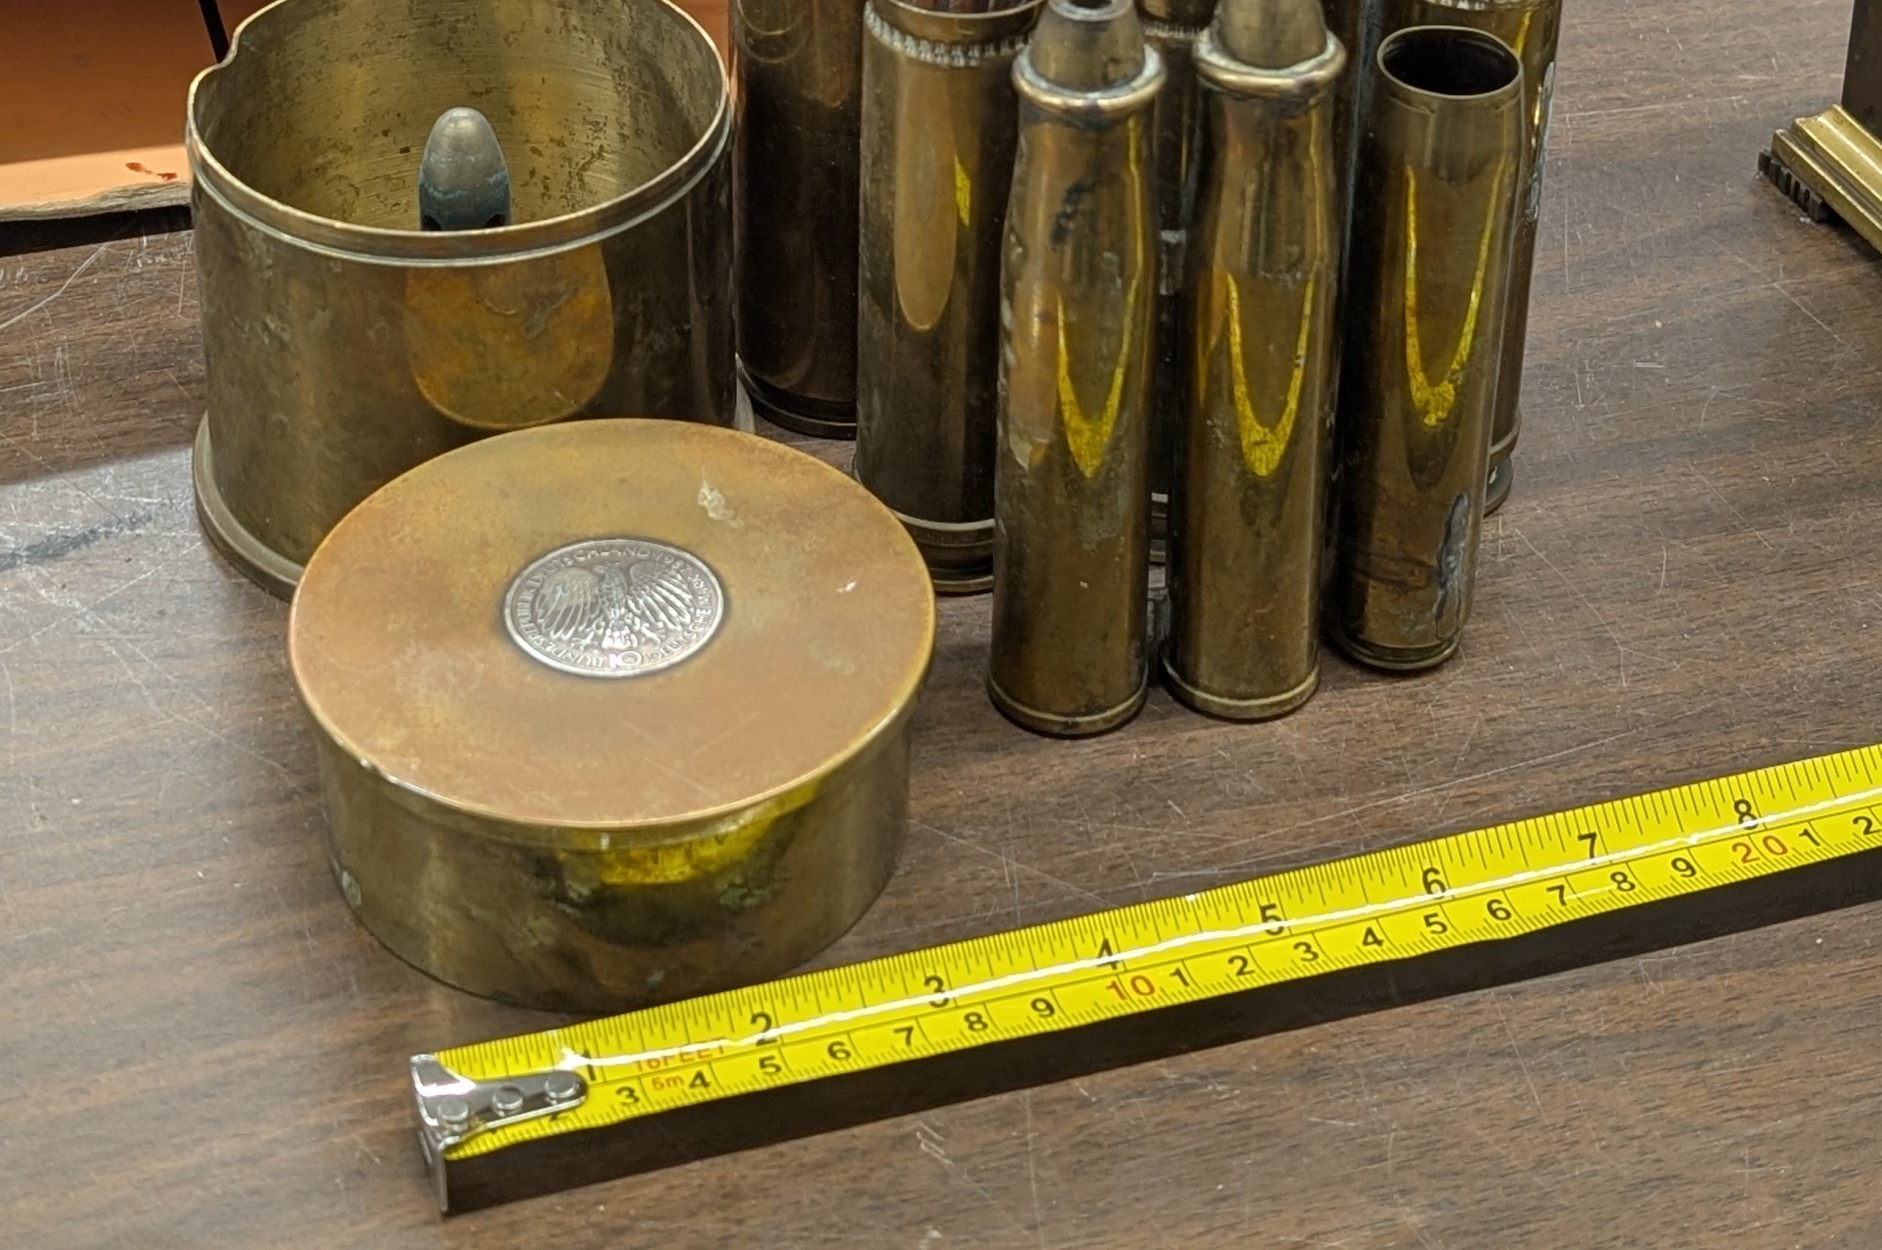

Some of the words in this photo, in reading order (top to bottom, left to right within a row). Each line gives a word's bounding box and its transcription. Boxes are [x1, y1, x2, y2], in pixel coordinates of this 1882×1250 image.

[615, 1085, 640, 1108] 3
[689, 1070, 713, 1090] 4
[758, 1055, 782, 1078] 5
[827, 1040, 852, 1062] 6
[894, 1025, 916, 1047] 7
[964, 1011, 989, 1033] 8
[1030, 997, 1056, 1019] 9
[1106, 973, 1157, 1001] 10
[1169, 967, 1193, 989] 1
[1227, 954, 1257, 978] 2
[1292, 940, 1319, 963] 3
[1361, 926, 1384, 951] 4
[1425, 912, 1449, 936] 5
[1487, 898, 1512, 922] 6
[1546, 884, 1569, 908] 7
[1610, 870, 1636, 893] 8
[1671, 856, 1697, 879] 9
[1731, 833, 1790, 865] 20
[1799, 827, 1823, 849] 1
[1852, 814, 1879, 837] 2
[750, 1011, 778, 1047] 2
[924, 974, 950, 1009] 3
[1096, 937, 1121, 972] 4
[1259, 902, 1287, 936] 5
[1421, 866, 1448, 900] 6
[1577, 831, 1600, 866] 7
[1733, 798, 1759, 831] 8
[651, 1074, 685, 1092] 5m
